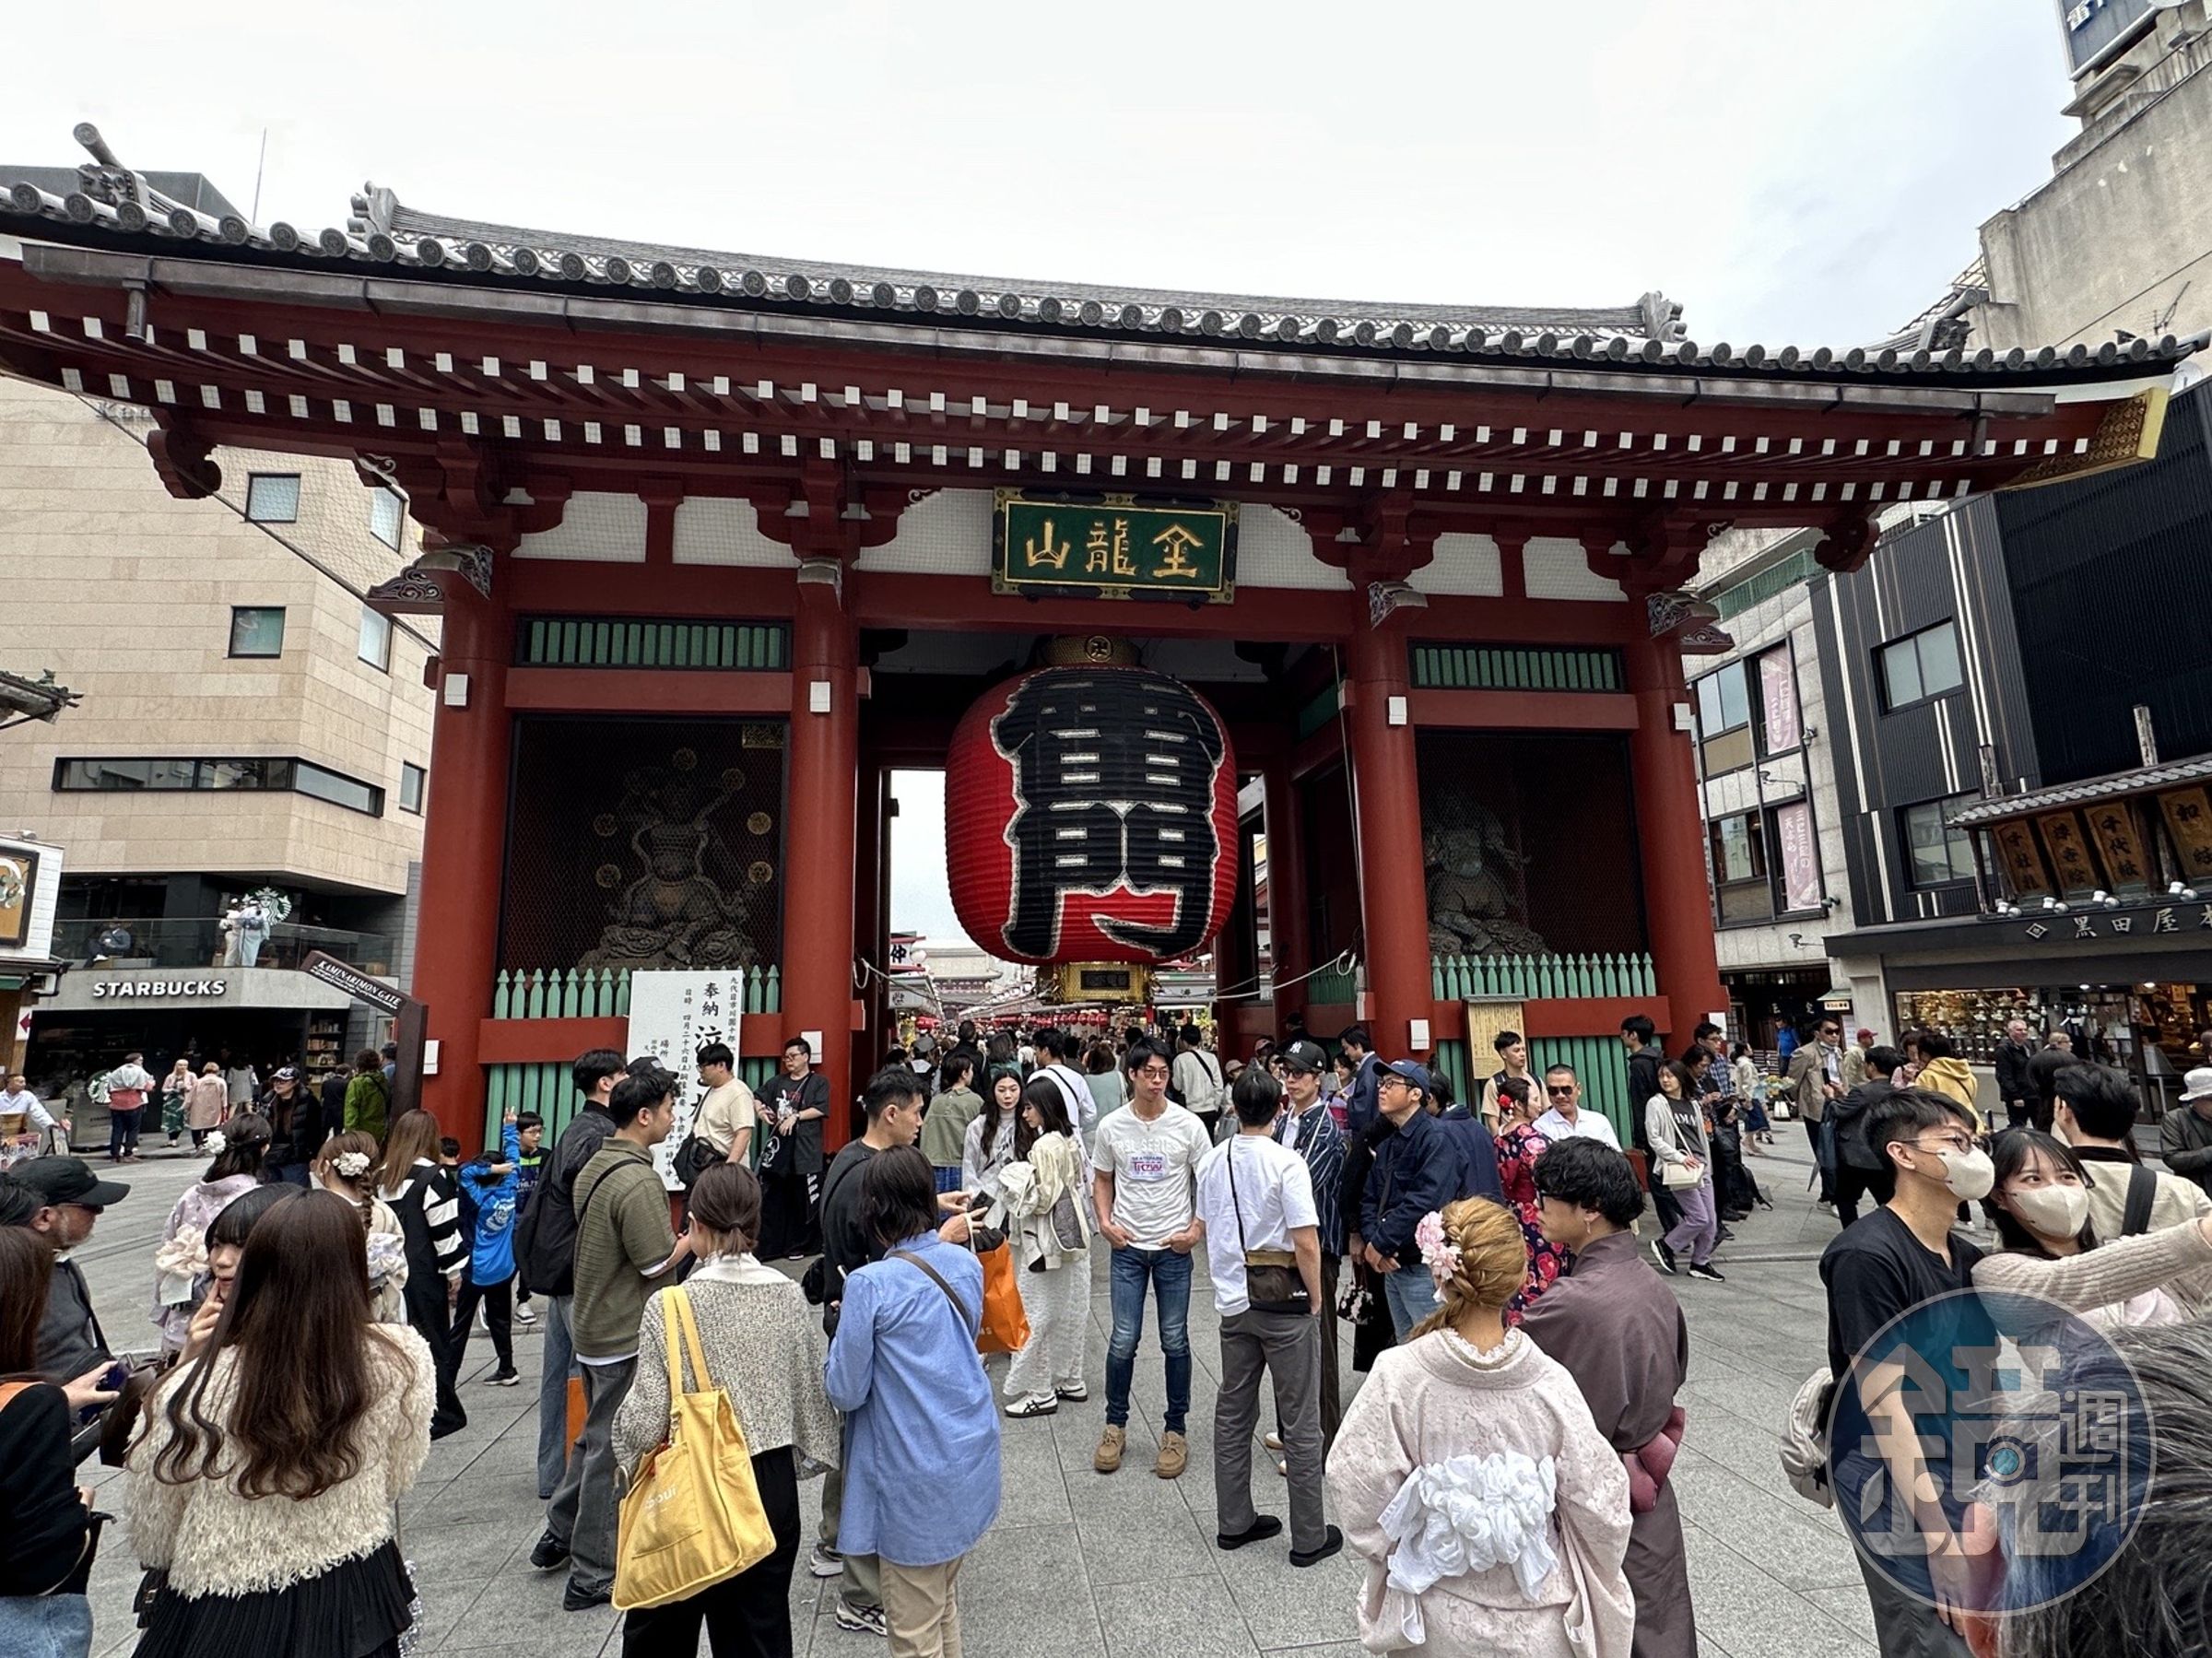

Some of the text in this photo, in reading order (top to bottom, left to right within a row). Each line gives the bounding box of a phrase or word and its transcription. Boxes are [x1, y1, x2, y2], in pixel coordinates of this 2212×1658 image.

[990, 666, 1226, 959] 雷門
[92, 980, 227, 997] STARBUCKS
[318, 960, 379, 994] KAMINARIMON
[377, 990, 402, 1006] GATE
[701, 982, 720, 1017] 奉納
